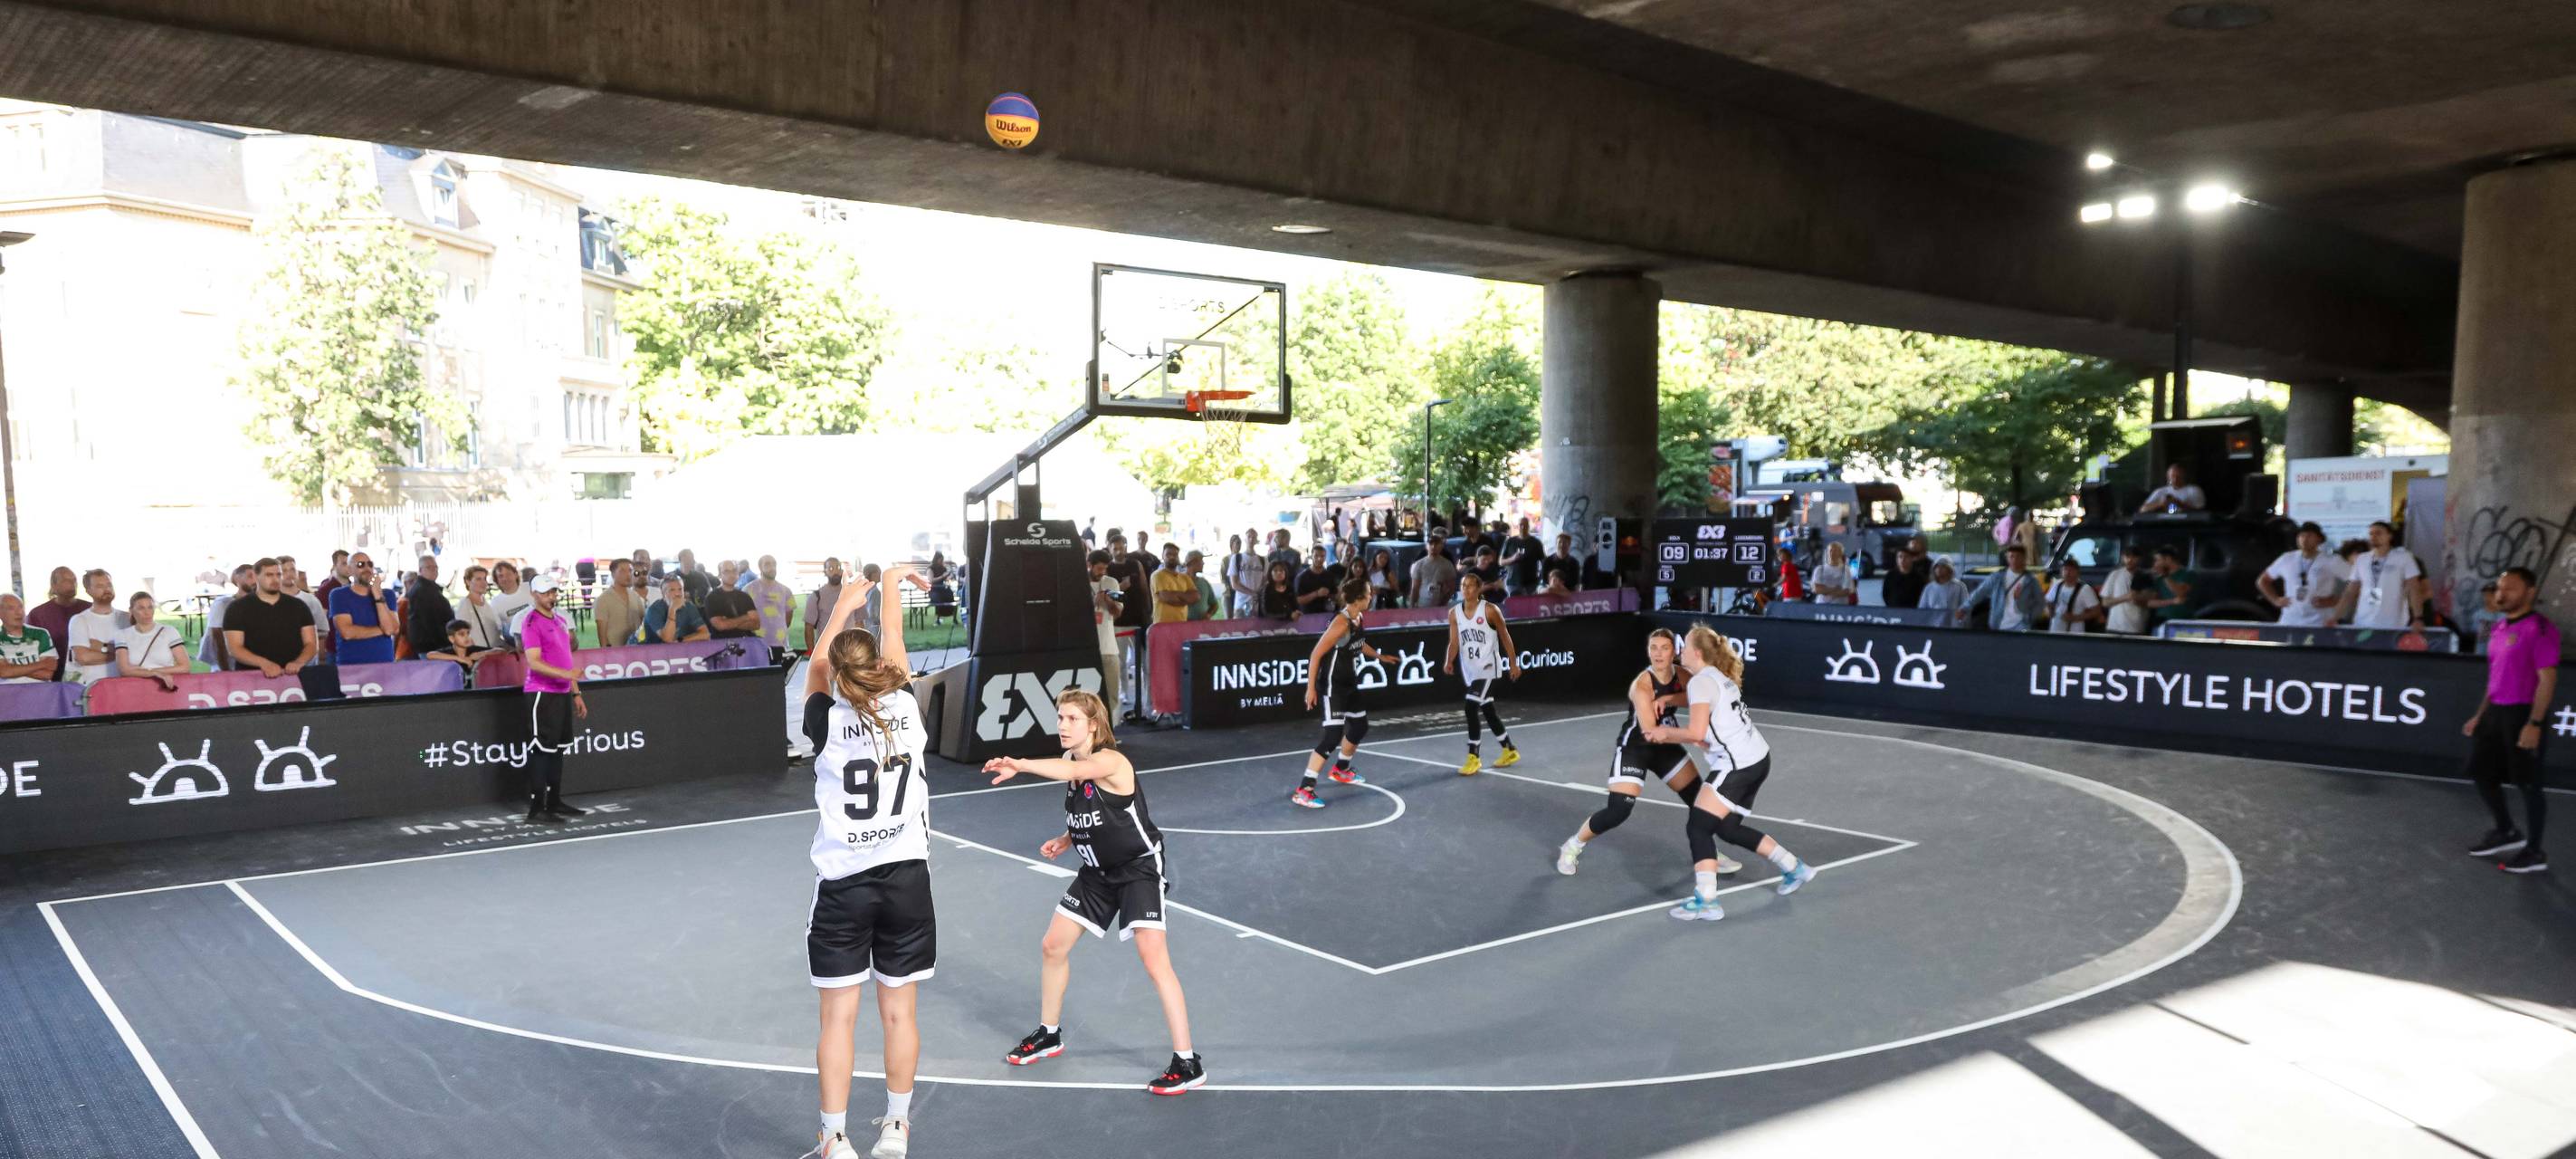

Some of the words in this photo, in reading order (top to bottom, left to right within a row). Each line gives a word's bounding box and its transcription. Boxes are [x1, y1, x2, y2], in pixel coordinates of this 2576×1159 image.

[997, 119, 1031, 133] Wilson
[1042, 538, 1072, 547] Sports
[1664, 547, 1684, 560] 09
[1694, 548, 1728, 560] 01:37
[1741, 547, 1759, 560] 12
[1468, 647, 1480, 659] 84
[2029, 664, 2230, 710] LIFESTYLE
[2242, 676, 2428, 725] HOTELS
[1241, 698, 1252, 708] BY
[424, 728, 645, 768] #Stayrious
[843, 752, 912, 820] 97
[1077, 844, 1100, 867] 91
